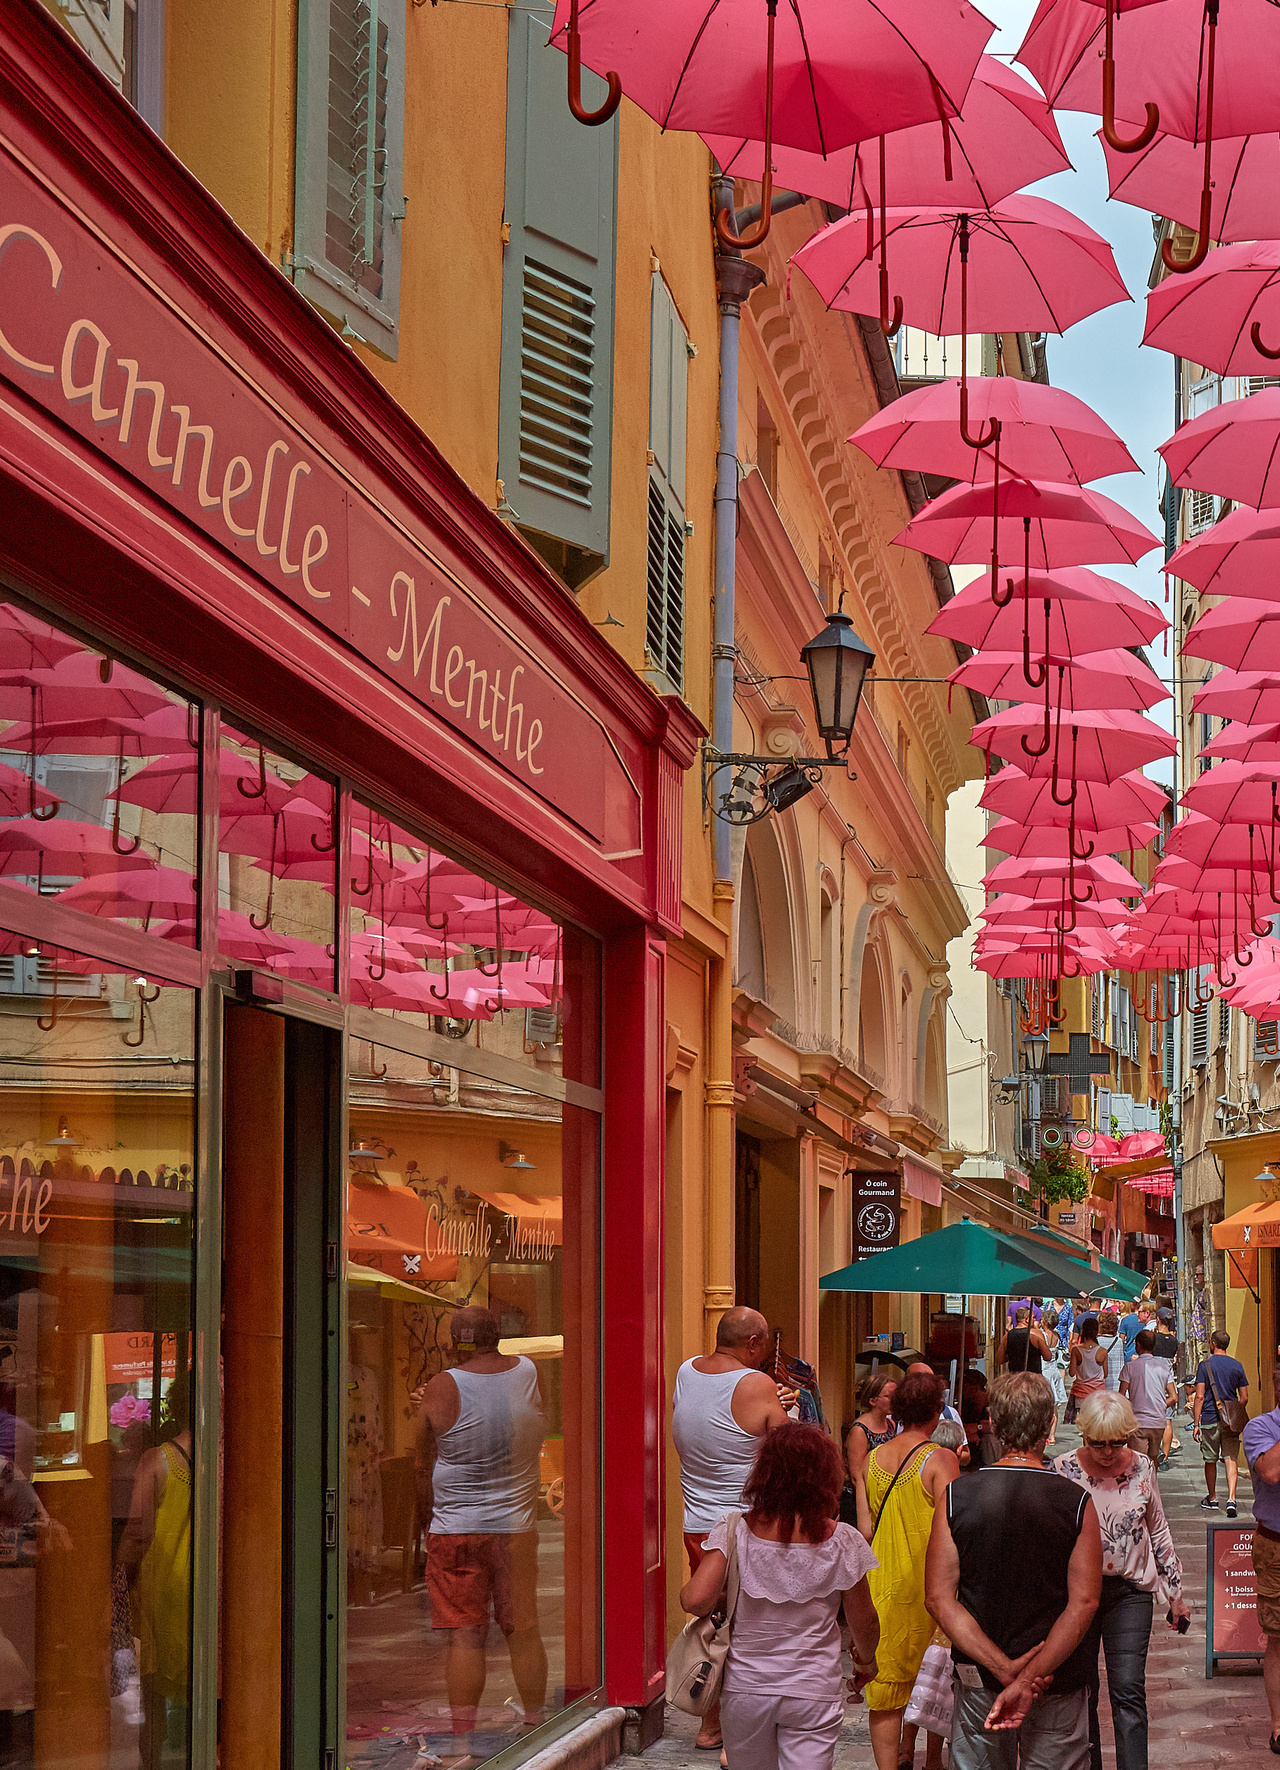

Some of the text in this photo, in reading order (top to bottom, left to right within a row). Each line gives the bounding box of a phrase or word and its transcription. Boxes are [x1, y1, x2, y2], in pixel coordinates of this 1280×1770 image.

[0, 223, 333, 600] Cannelle
[385, 569, 546, 775] Menthe
[858, 1188, 895, 1196] Gourmand
[425, 1201, 492, 1262] Cannelle
[505, 1209, 556, 1262] Menthe
[1230, 1569, 1256, 1577] sandwi
[1236, 1601, 1257, 1609] desse
